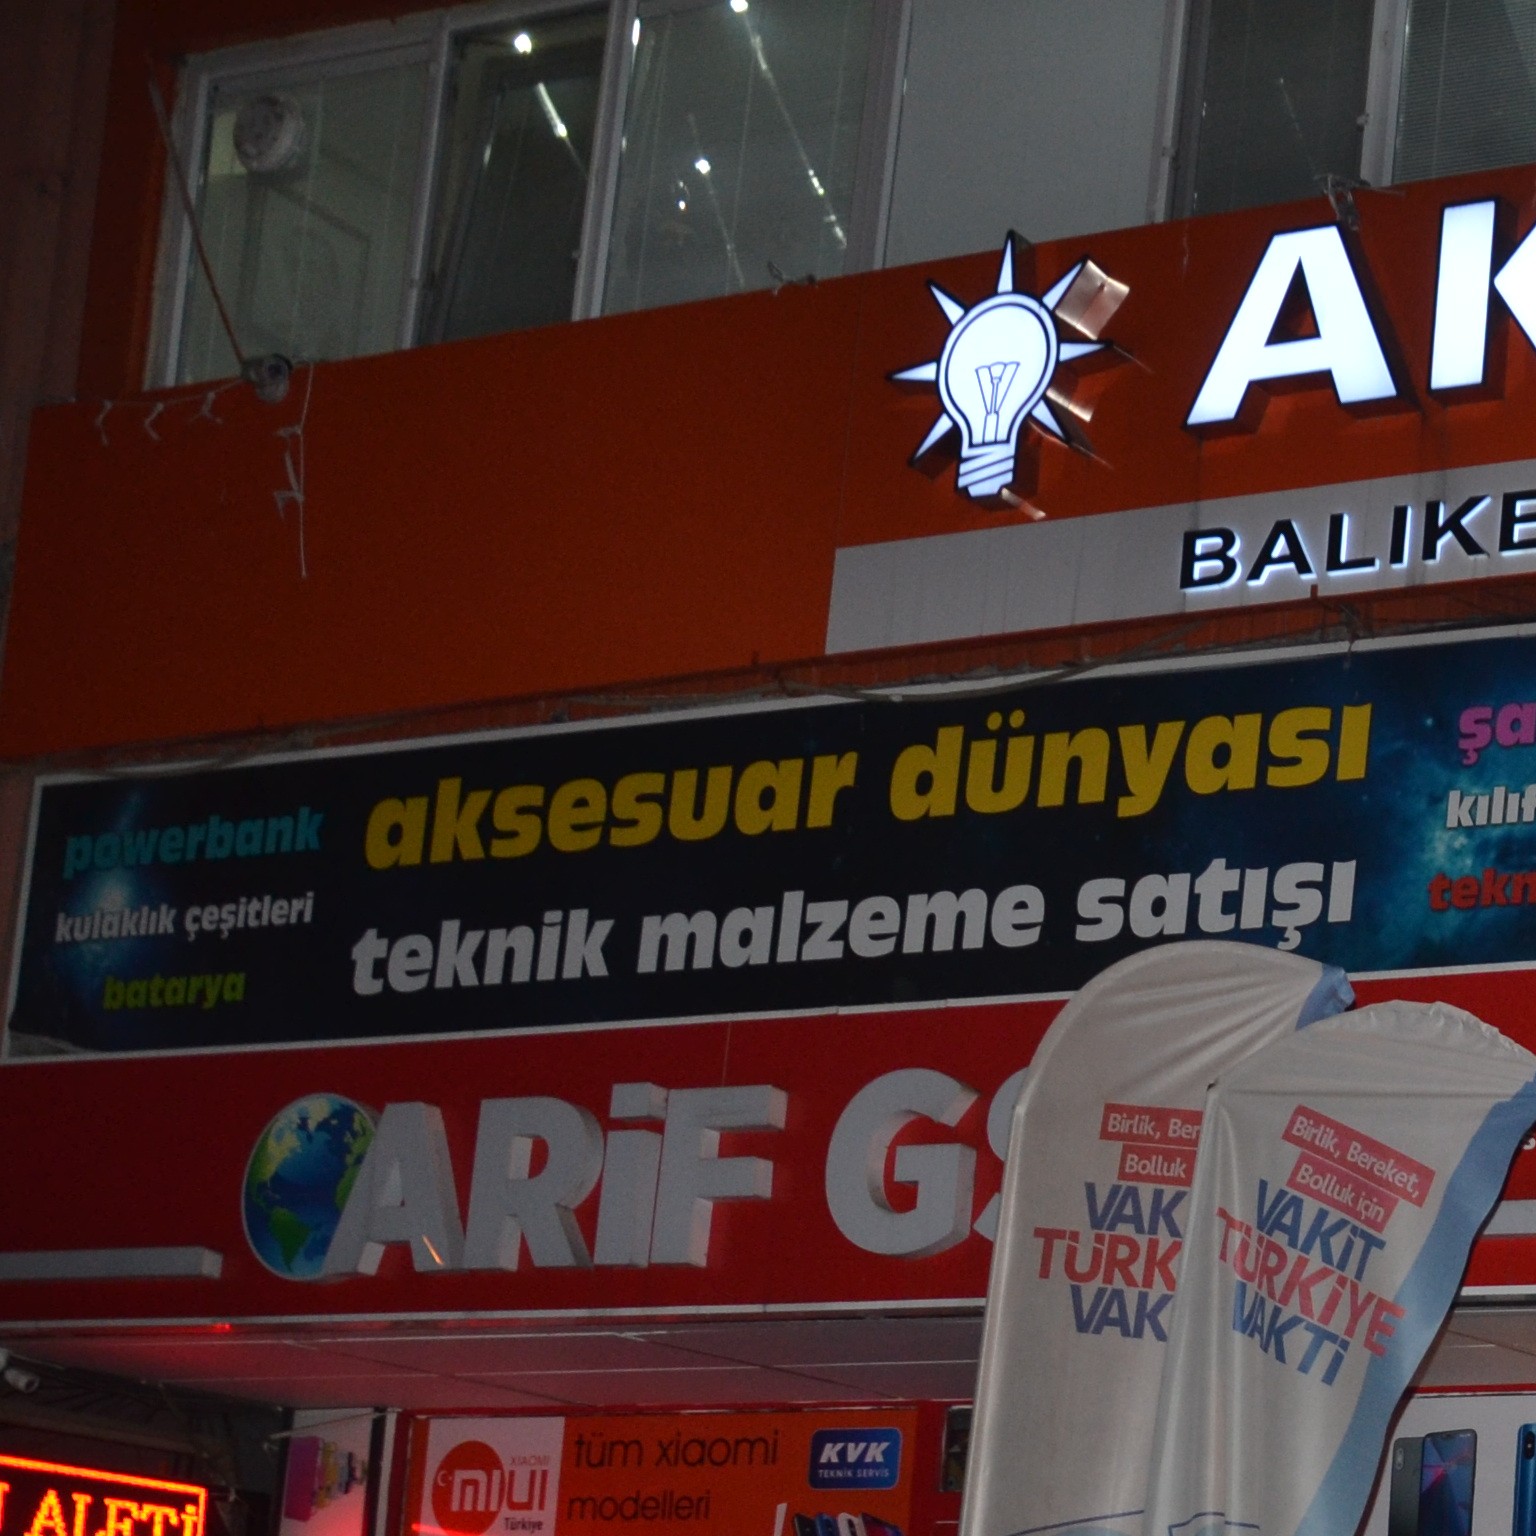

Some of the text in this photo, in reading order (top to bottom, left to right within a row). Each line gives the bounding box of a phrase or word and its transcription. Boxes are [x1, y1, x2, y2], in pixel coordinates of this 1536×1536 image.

[363, 702, 1372, 870] aksesuar dünyası
[62, 805, 325, 880] powerbank
[55, 891, 315, 943] kulaklık çeşitleri
[349, 857, 1357, 996] teknik malzeme satışı
[103, 971, 247, 1010] batarya
[1108, 1113, 1201, 1140] Birlik, Ber
[322, 1082, 788, 1280] ARİF
[1125, 1153, 1187, 1179] Bolluk
[1291, 1116, 1420, 1199] Birlik, Bereket,
[1084, 1181, 1189, 1240] VAK
[1296, 1163, 1385, 1222] Bolluk için
[1033, 1226, 1183, 1292] TÜRK
[1216, 1206, 1407, 1358] TÜRKİYE
[1070, 1283, 1174, 1343] VAK
[575, 1429, 780, 1469] tüm xiaomi
[818, 1467, 853, 1479] TEKNİK
[820, 1442, 891, 1464] KVK
[504, 1517, 544, 1534] Türkiye
[566, 1489, 711, 1522] modelleri
